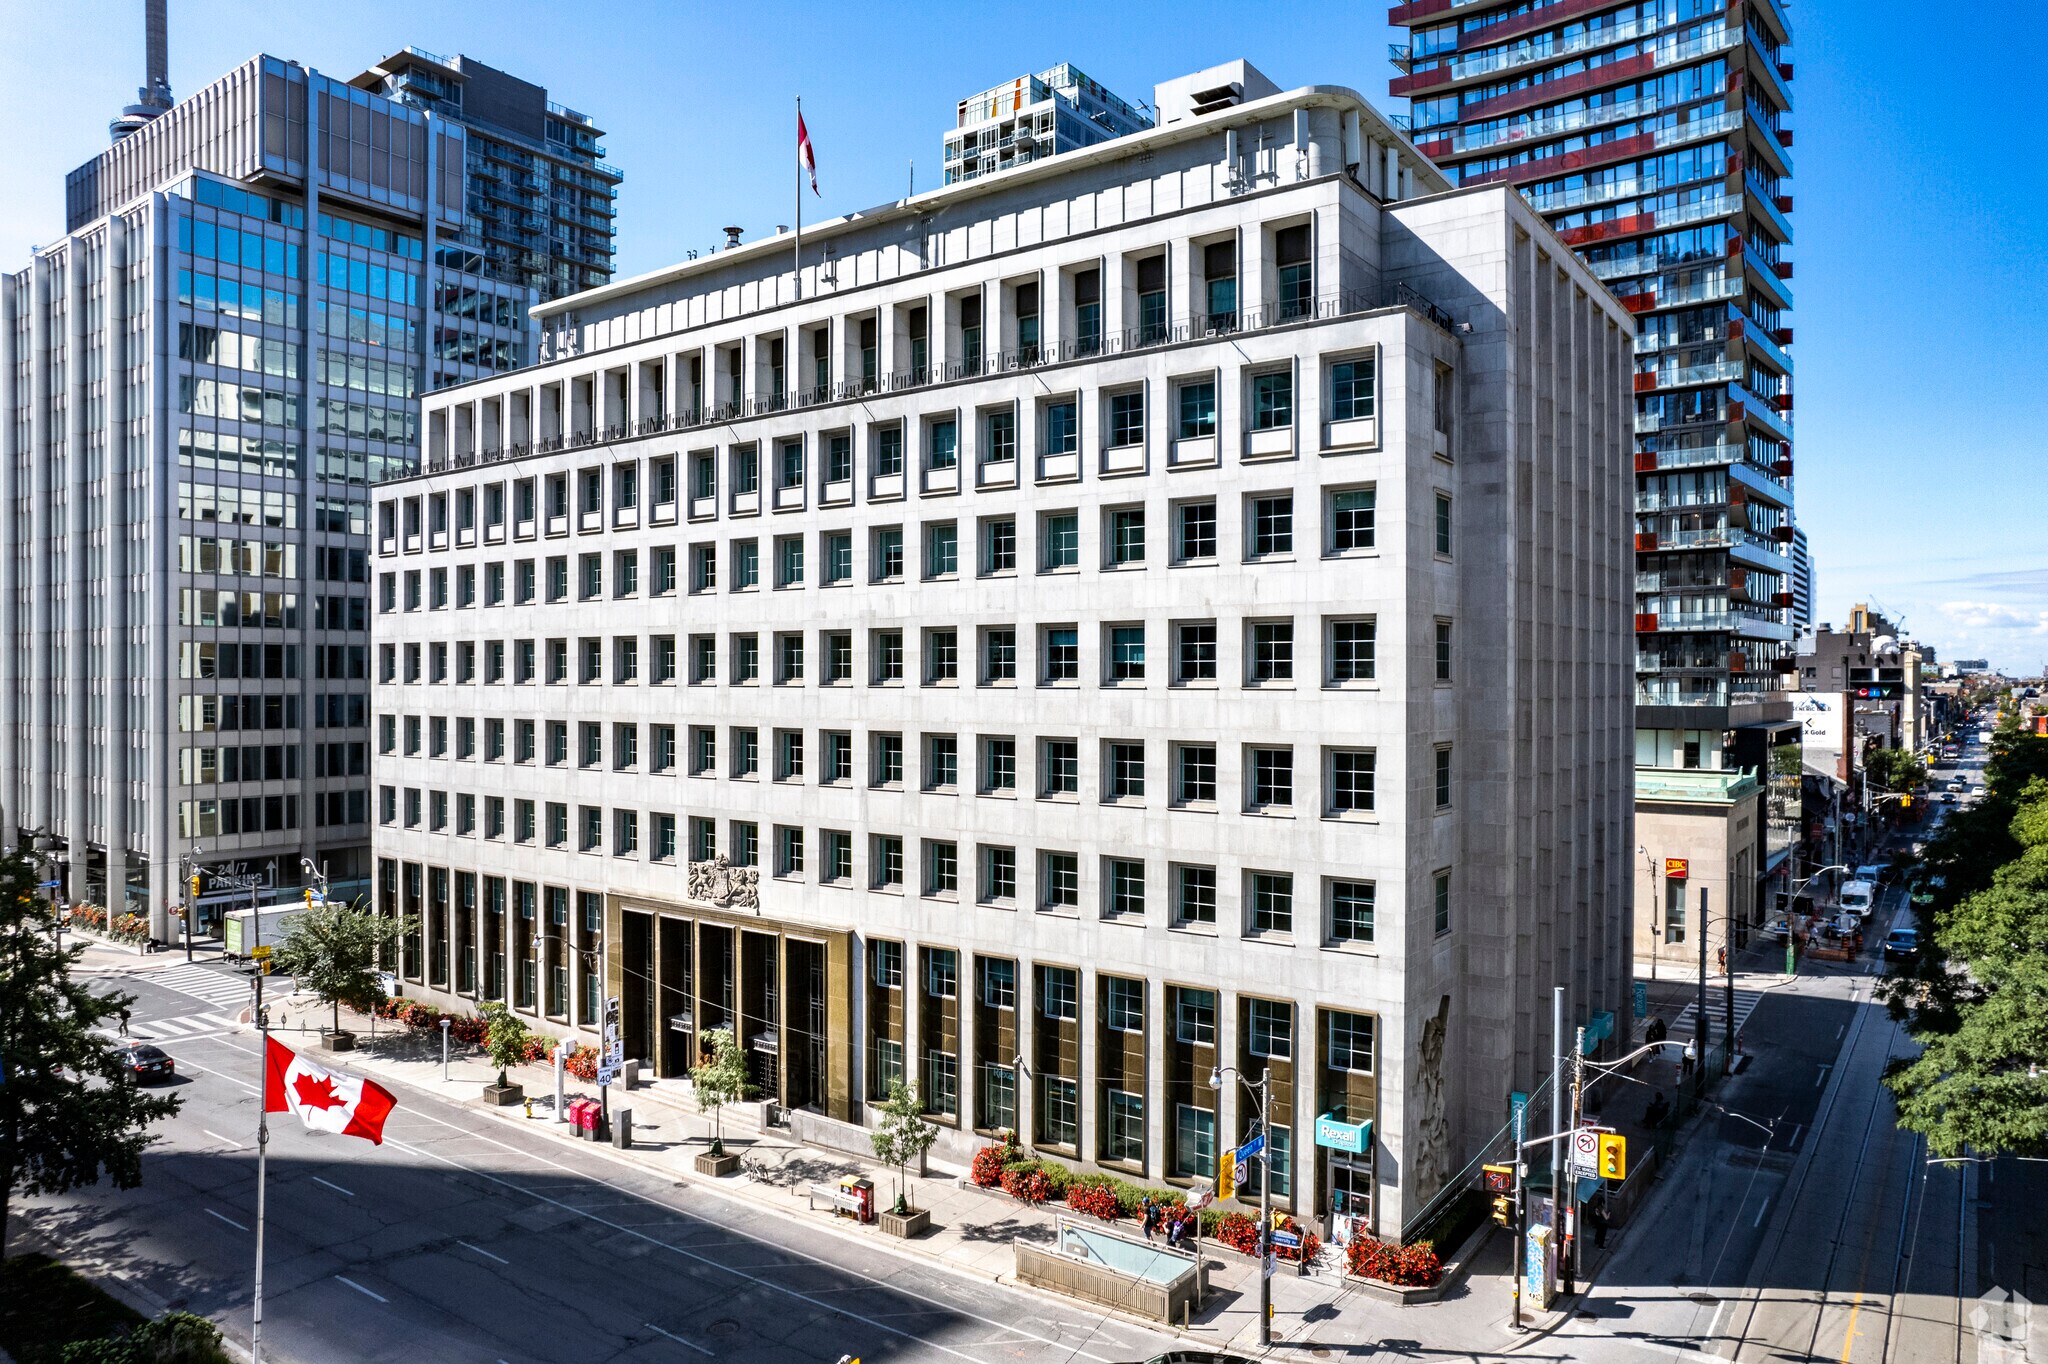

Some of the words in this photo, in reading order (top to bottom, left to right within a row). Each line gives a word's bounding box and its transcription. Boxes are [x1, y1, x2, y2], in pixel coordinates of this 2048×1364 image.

[218, 862, 248, 876] 24/7
[1667, 860, 1686, 869] CIBC
[208, 873, 262, 889] PARKING
[1636, 988, 1646, 1013] Rexall
[600, 1074, 611, 1083] 40
[1322, 1125, 1356, 1143] Rexall
[1239, 1144, 1253, 1159] Queen
